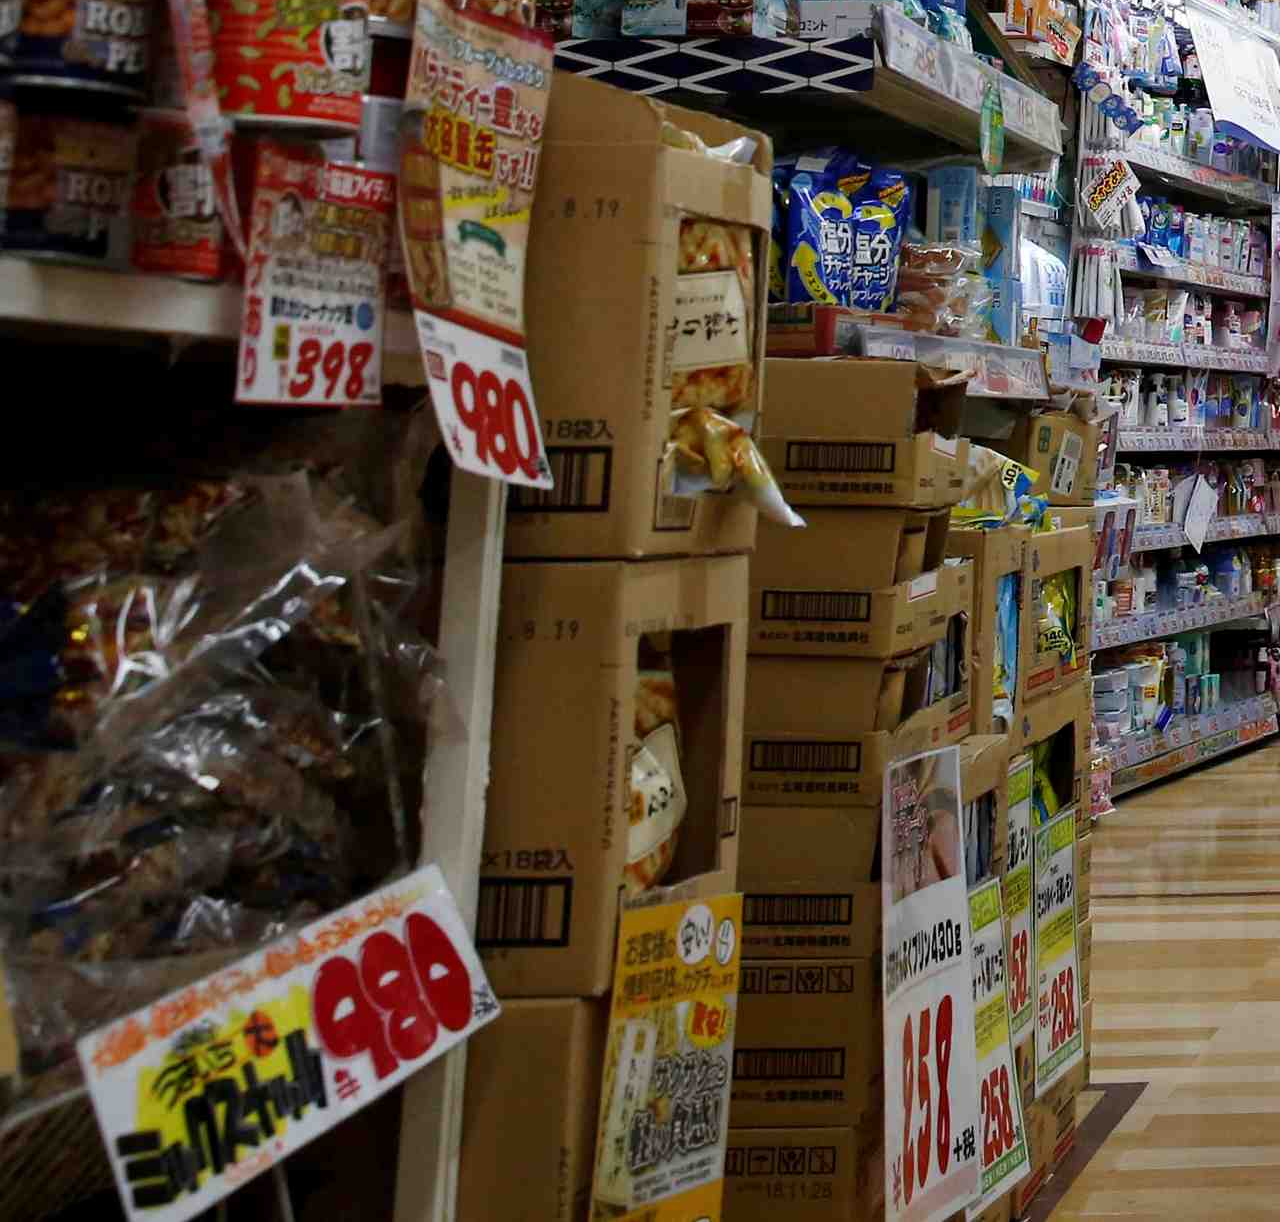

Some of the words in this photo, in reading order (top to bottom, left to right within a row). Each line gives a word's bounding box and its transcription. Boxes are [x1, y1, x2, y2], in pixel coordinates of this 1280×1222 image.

[851, 264, 891, 286] チャージ
[855, 232, 893, 265] 塩分
[288, 341, 376, 400] 398
[449, 359, 541, 478] 980
[311, 912, 472, 1080] 980
[1050, 966, 1077, 1053] 258
[902, 994, 955, 1205] 258
[952, 1125, 977, 1162] +税
[982, 1064, 1015, 1168] 258
